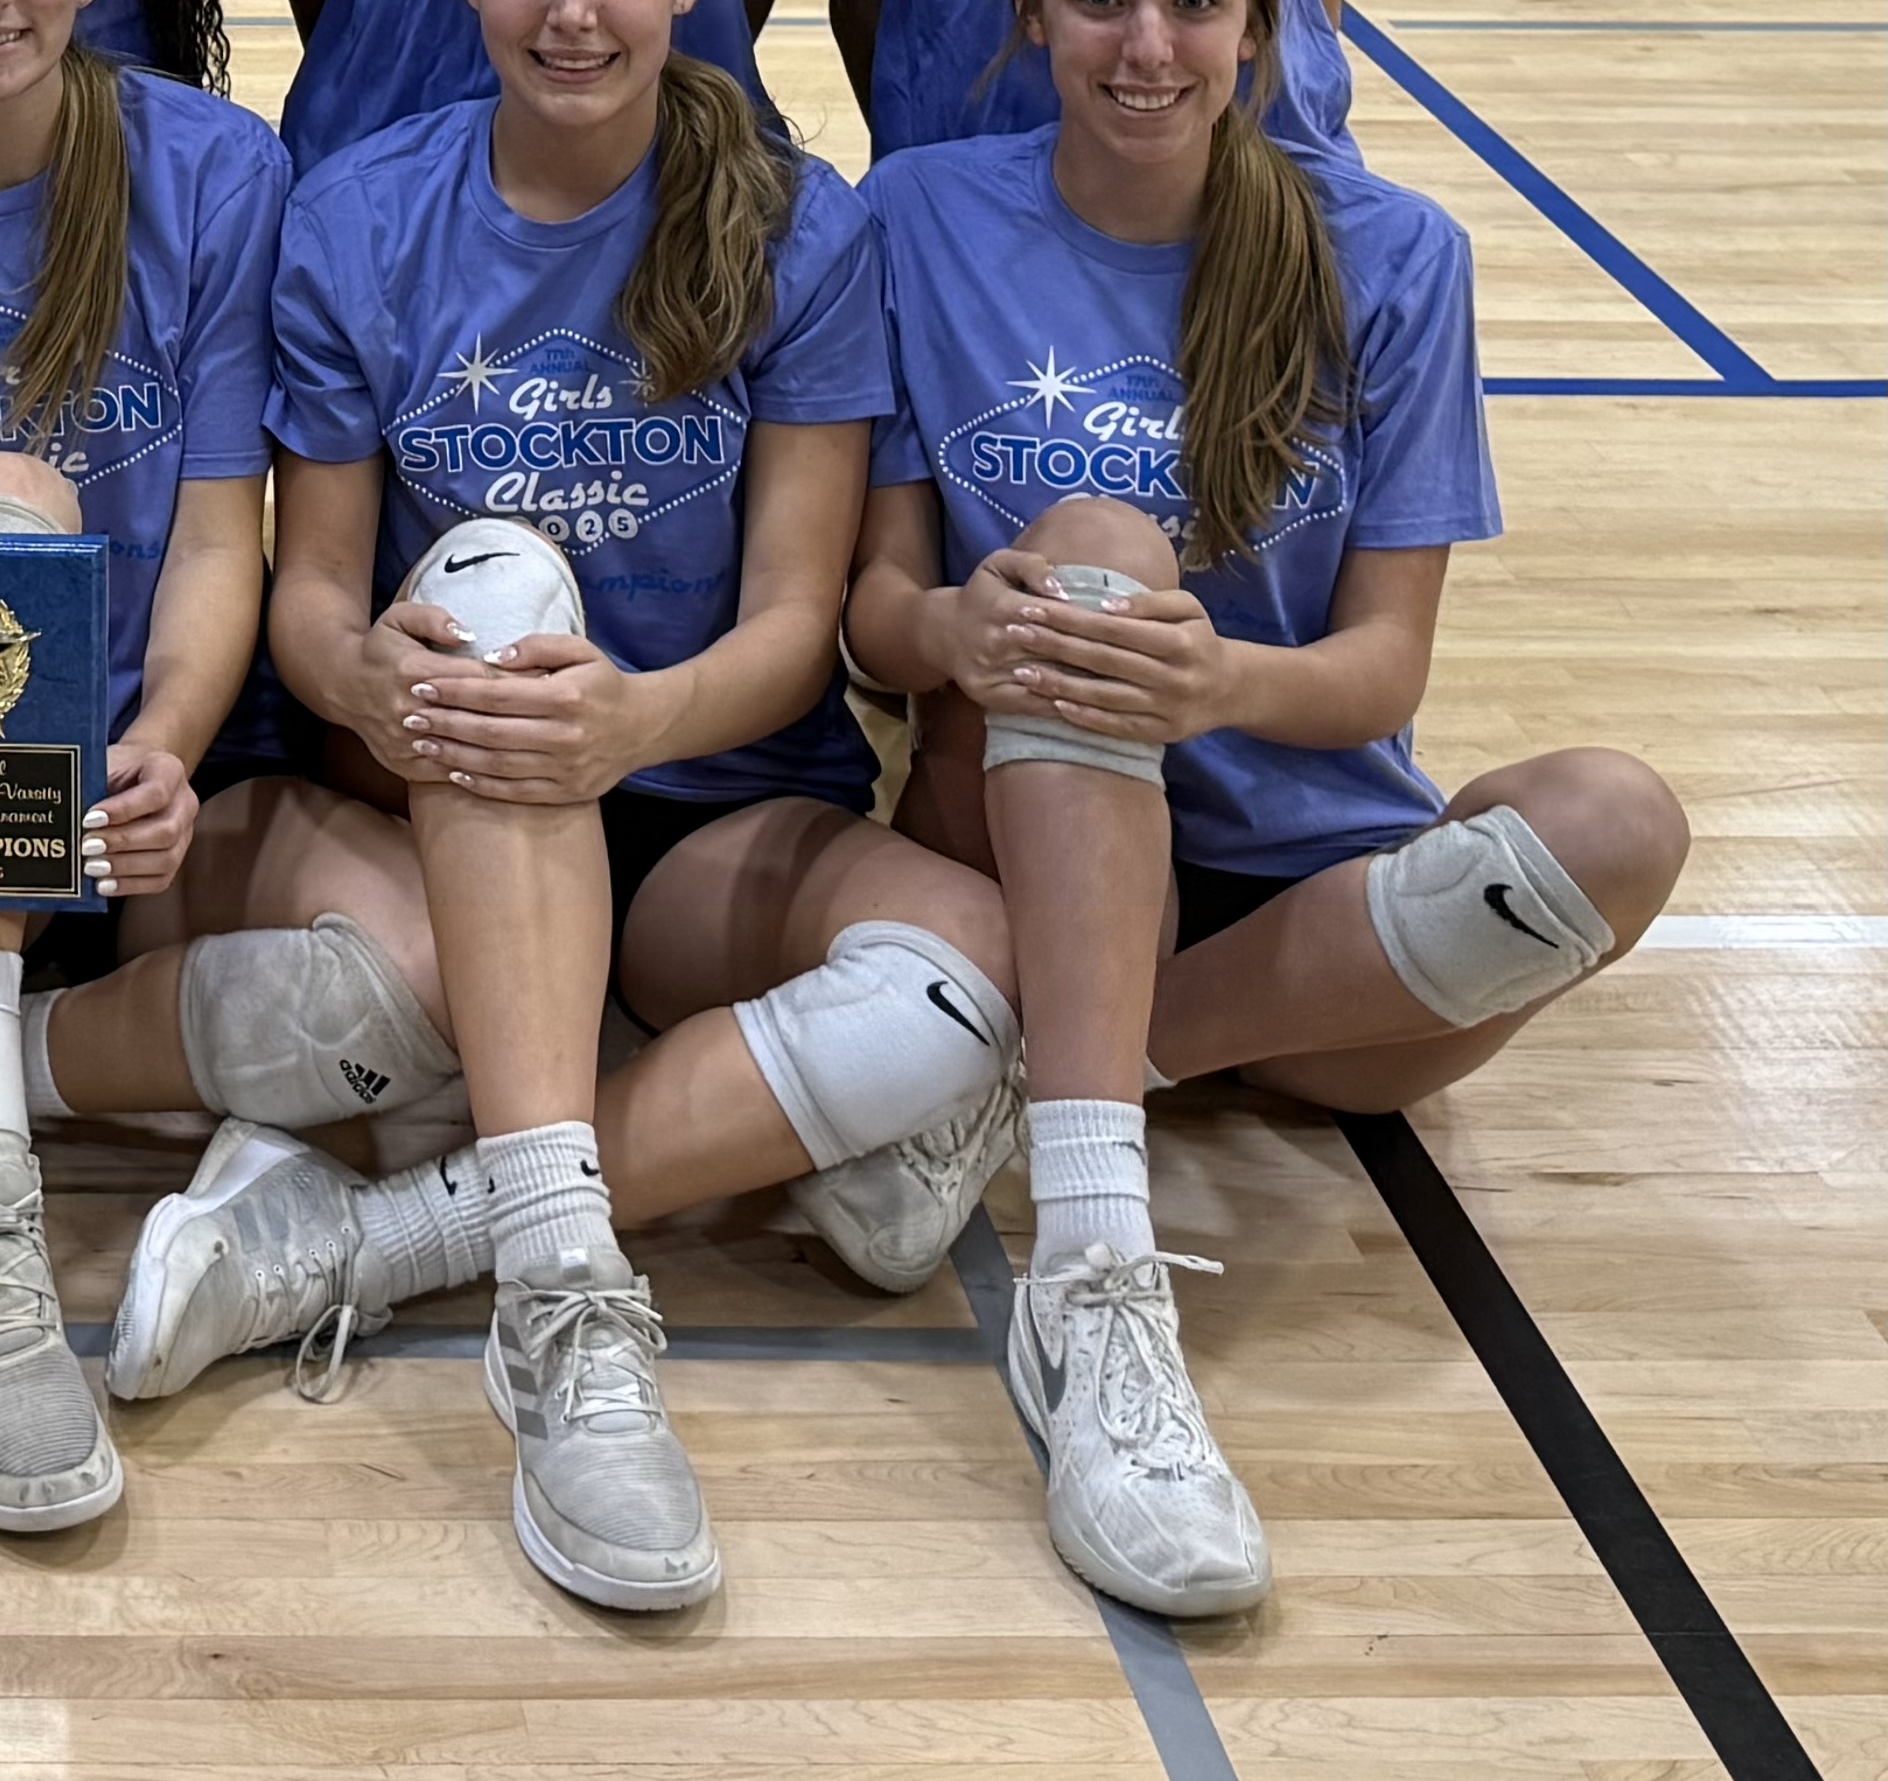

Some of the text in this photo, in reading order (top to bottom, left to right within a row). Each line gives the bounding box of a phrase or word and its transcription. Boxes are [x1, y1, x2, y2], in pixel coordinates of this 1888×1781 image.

[509, 376, 613, 421] Girls
[1083, 400, 1186, 442] Girl
[397, 415, 725, 474] STOCKTON
[484, 470, 650, 514] Classic
[970, 430, 1320, 510] STOCKN
[339, 1059, 377, 1105] adidas
